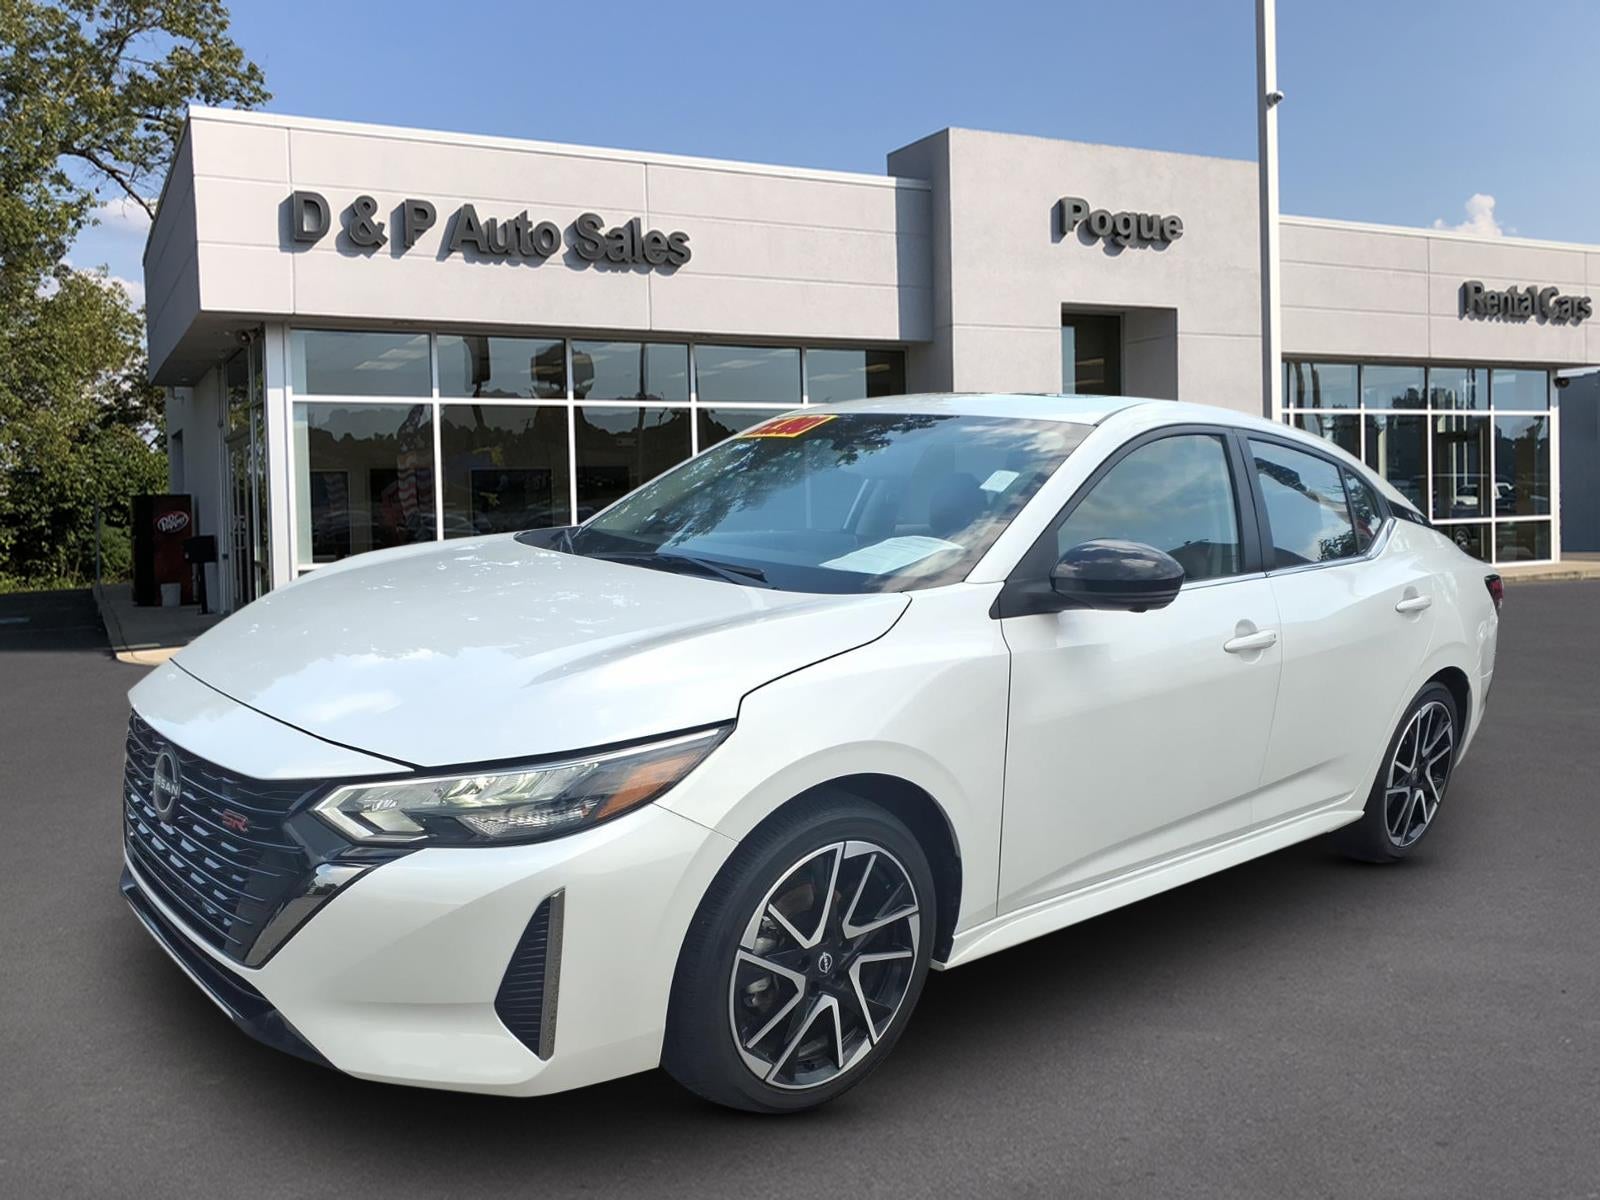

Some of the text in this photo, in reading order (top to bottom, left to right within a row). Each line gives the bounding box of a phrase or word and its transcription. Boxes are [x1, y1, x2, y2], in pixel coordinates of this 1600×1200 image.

[293, 191, 692, 266] D & P Auto Sales
[1062, 196, 1184, 247] Pogue
[1463, 280, 1593, 323] Rental Cars
[154, 773, 178, 797] SSAN
